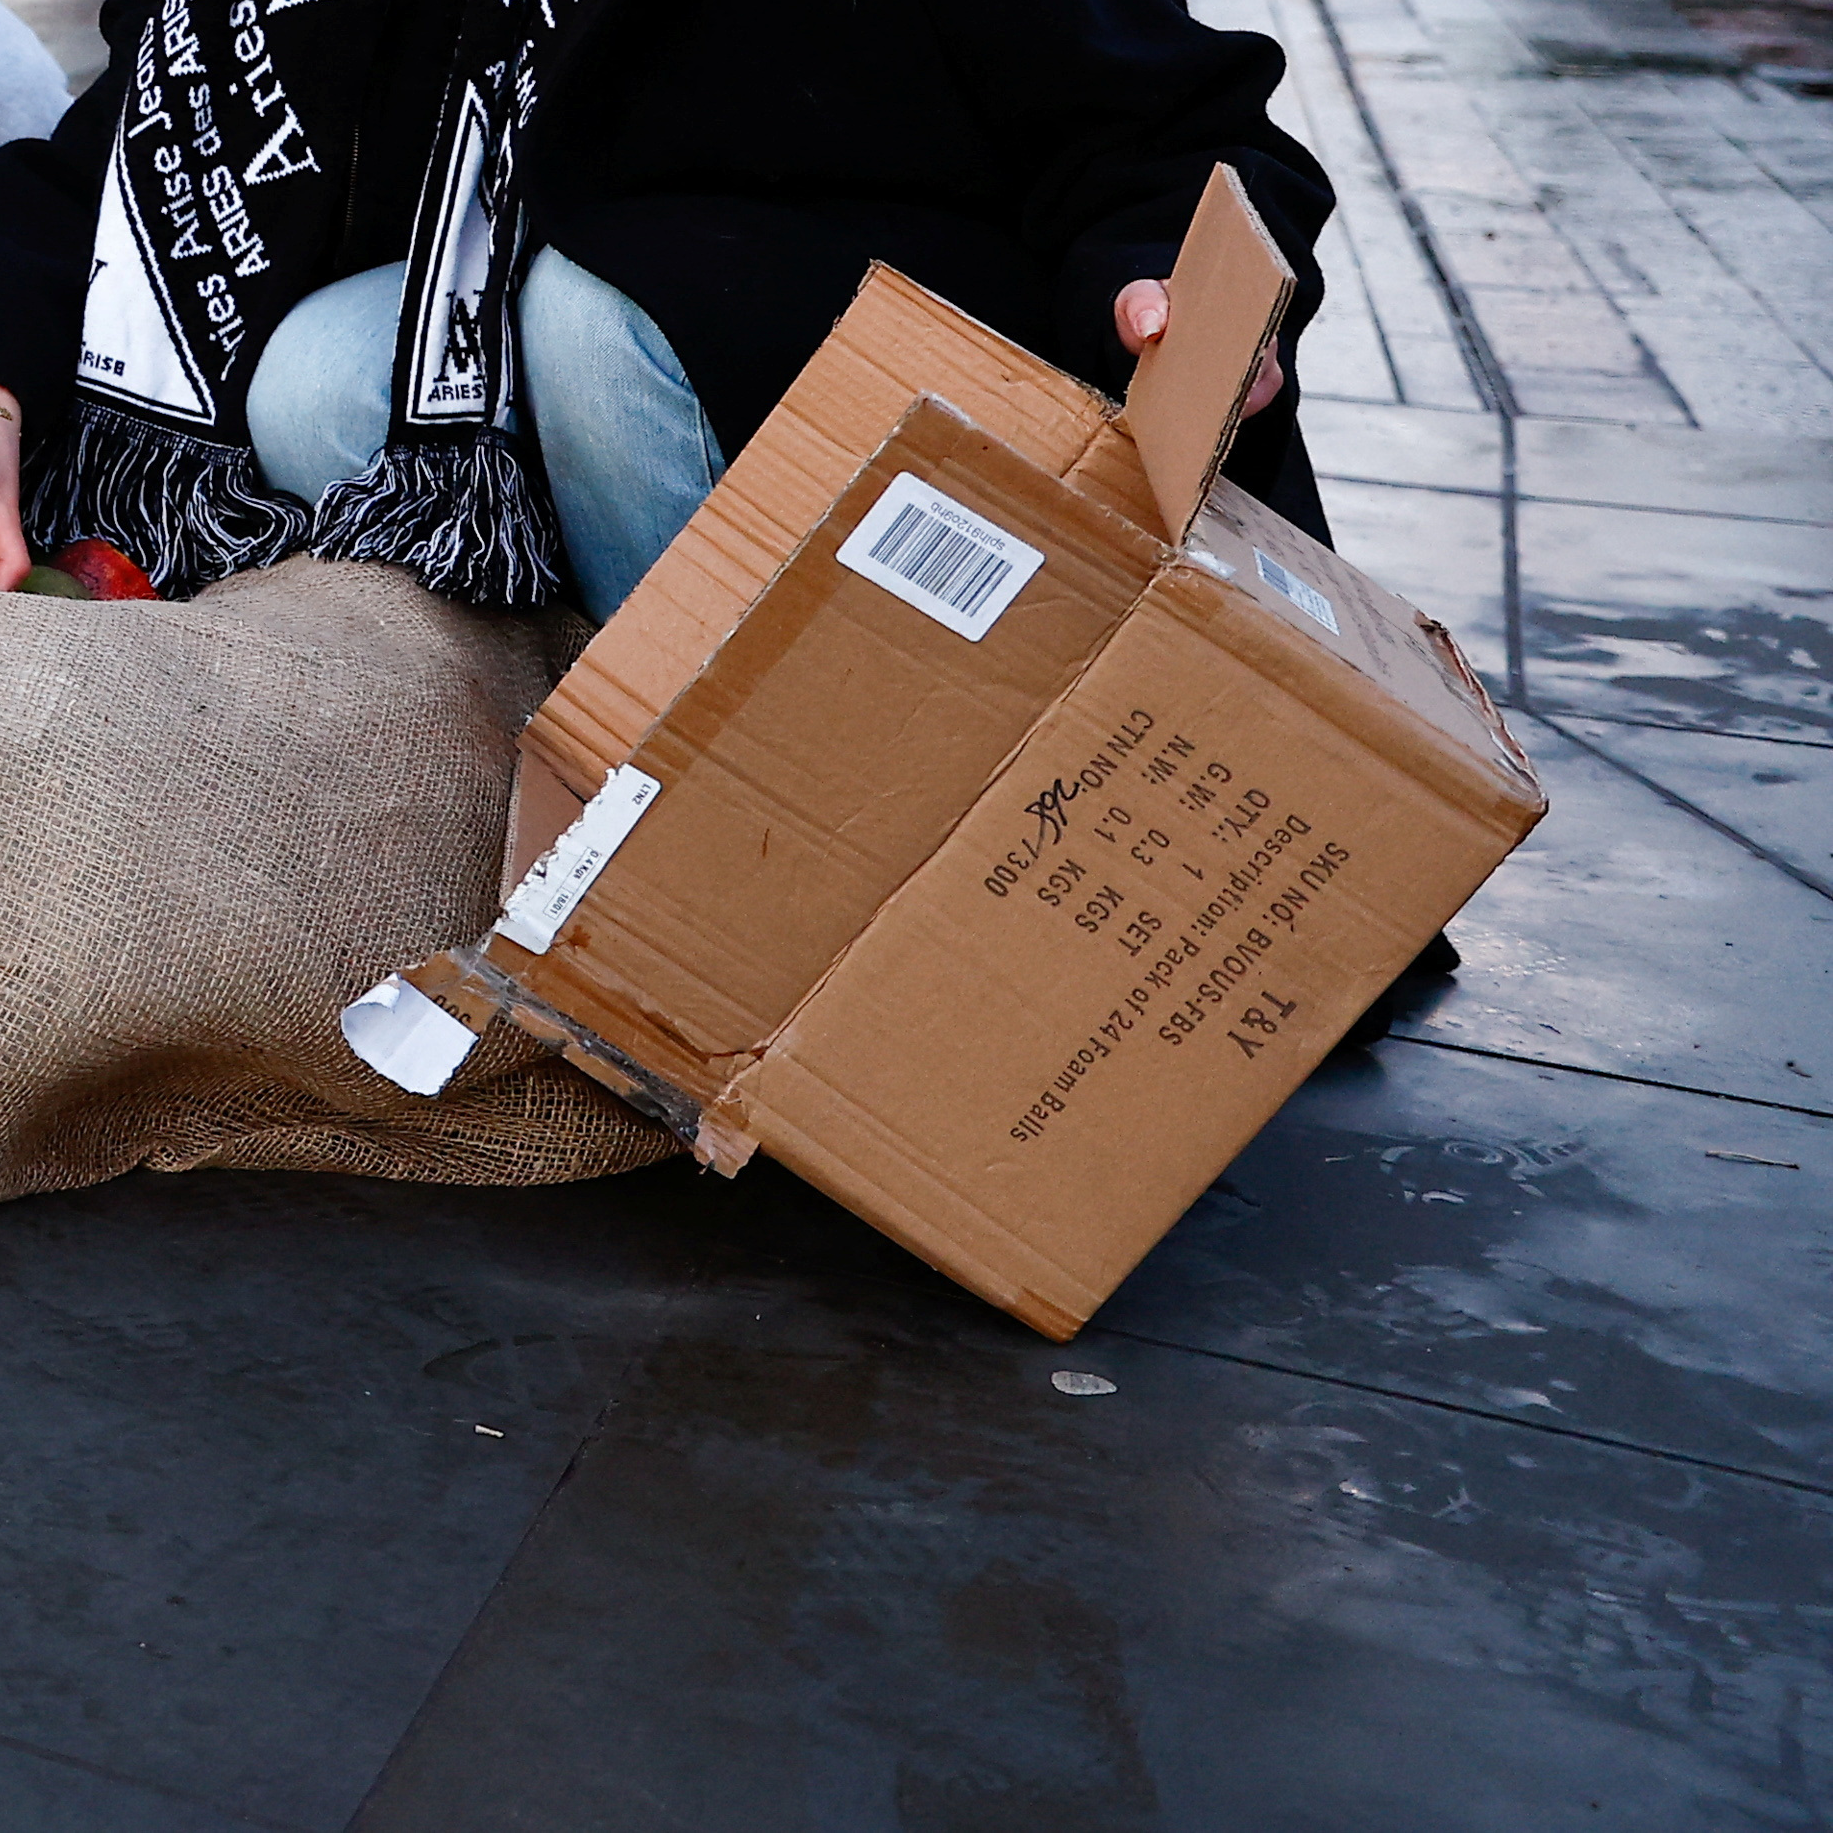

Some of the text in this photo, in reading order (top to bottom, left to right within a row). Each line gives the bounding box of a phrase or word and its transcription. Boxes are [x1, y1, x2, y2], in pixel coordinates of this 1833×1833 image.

[128, 17, 173, 139] Jeans
[188, 83, 223, 157] des
[154, 145, 213, 260] Arise
[202, 164, 271, 277] ARIES
[80, 349, 126, 377] RISE
[427, 383, 484, 403] ARIES
[1107, 711, 1153, 757] CTN
[1038, 735, 1195, 906] N.W: 0.1 KGS
[1075, 763, 1231, 932] G.W: 0.3 KGS
[1182, 864, 1203, 880] 1
[1300, 843, 1349, 891] SKU
[1118, 911, 1161, 956] SET
[1263, 887, 1309, 928] NO:
[1010, 815, 1311, 1141] Description: Pack of 24 Foam Balls
[1227, 992, 1296, 1059] T&Y
